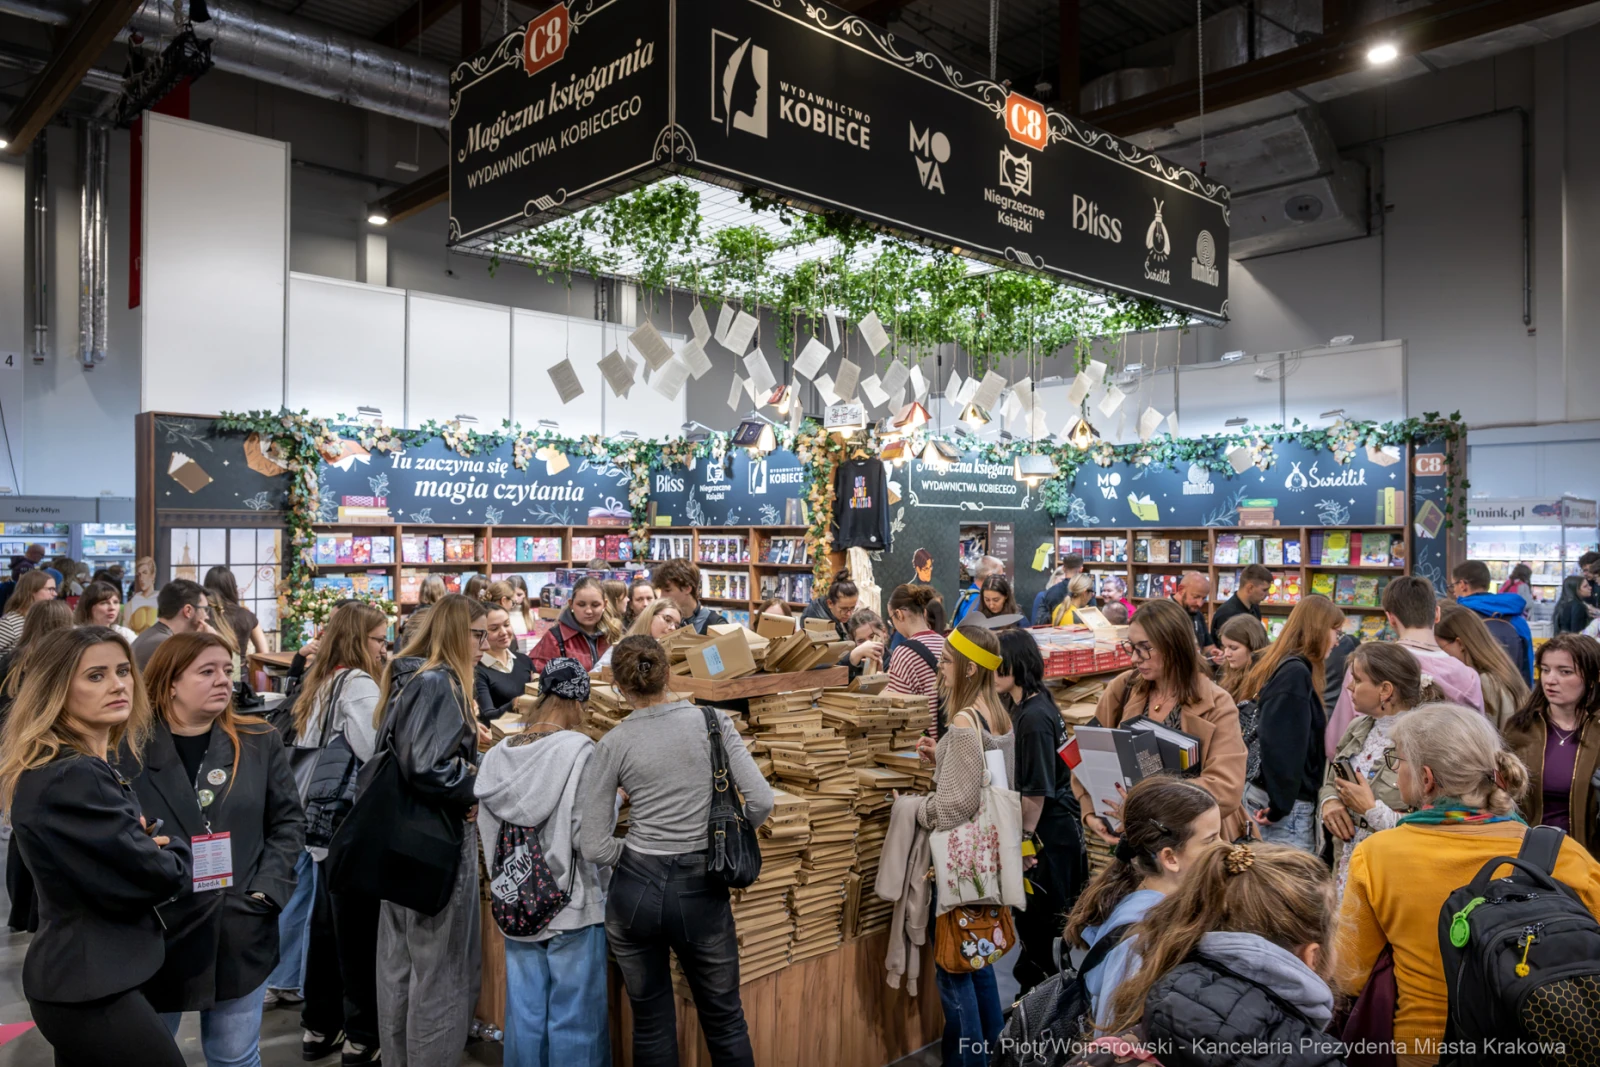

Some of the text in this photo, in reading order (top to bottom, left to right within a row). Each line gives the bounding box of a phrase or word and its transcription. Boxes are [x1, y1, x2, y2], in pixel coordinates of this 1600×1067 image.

[529, 16, 562, 63] C8
[458, 38, 655, 163] Magiczna księgarnia
[780, 81, 870, 124] WYDAWNICTWO
[780, 95, 870, 151] KOBIECE
[1011, 102, 1042, 141] C8
[467, 95, 642, 189] WYDAWNICTWA KOBIECEGO
[984, 188, 1045, 220] Niegrzeczne
[997, 211, 1032, 234] Książki
[1072, 194, 1122, 243] Bliss
[5, 354, 14, 368] 4
[390, 450, 509, 478] Tu zaczyna się
[974, 459, 1014, 479] księgarn
[1308, 460, 1368, 488] Świetlik
[1416, 457, 1441, 472] C8
[414, 475, 585, 506] magia czytania
[656, 475, 684, 492] Bliss
[700, 484, 731, 493] Niegrzeczne
[769, 473, 804, 484] KOBIECE
[921, 480, 1017, 495] WYDAWNICTWA KOBIECEGO
[40, 506, 60, 514] Młyn
